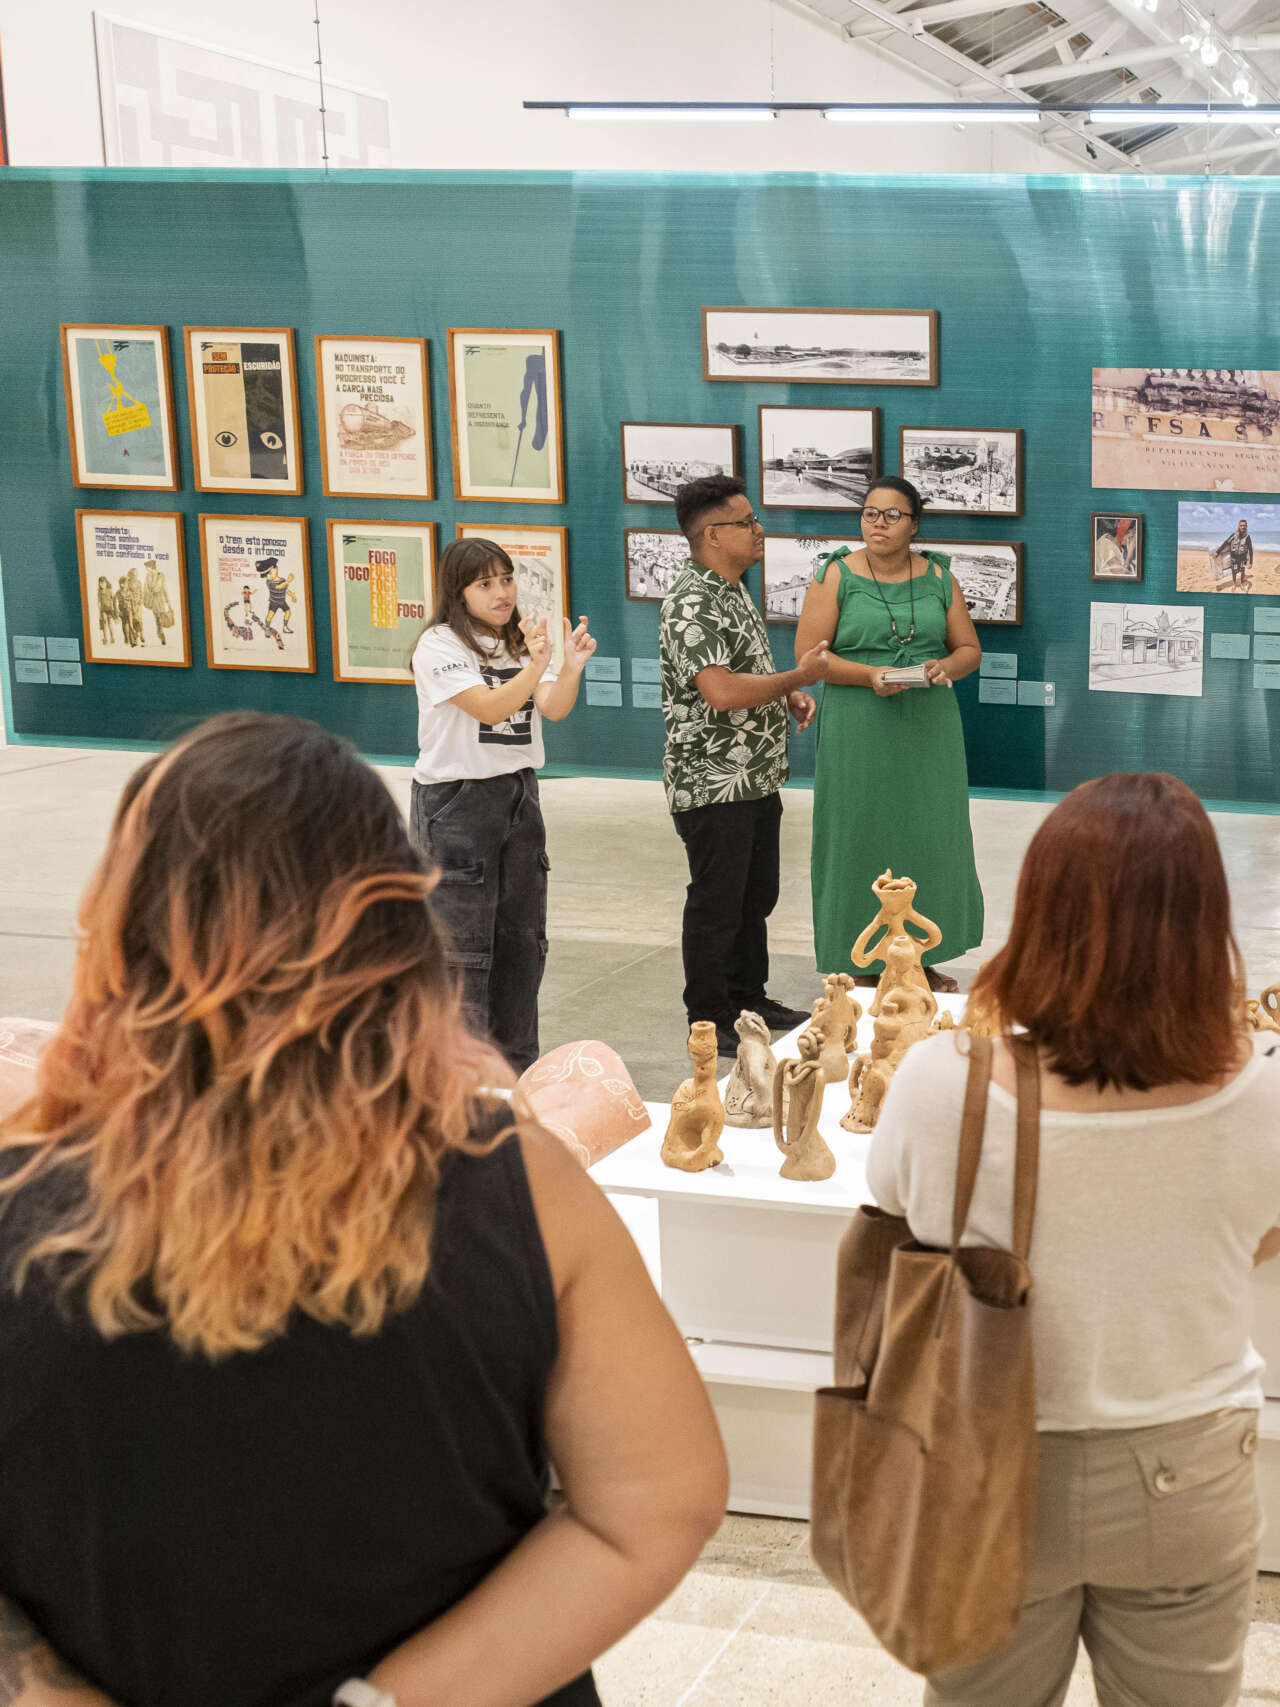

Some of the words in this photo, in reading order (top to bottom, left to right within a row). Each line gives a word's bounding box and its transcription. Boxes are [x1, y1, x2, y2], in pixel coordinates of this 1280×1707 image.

[347, 365, 392, 374] TRANSPORTE
[336, 374, 376, 383] PROGRESSO
[360, 394, 394, 402] PRECIOSA
[225, 535, 242, 544] trem
[222, 544, 244, 554] desde
[368, 550, 396, 565] FOGO
[344, 566, 369, 581] FOGO
[398, 603, 424, 619] FOGO
